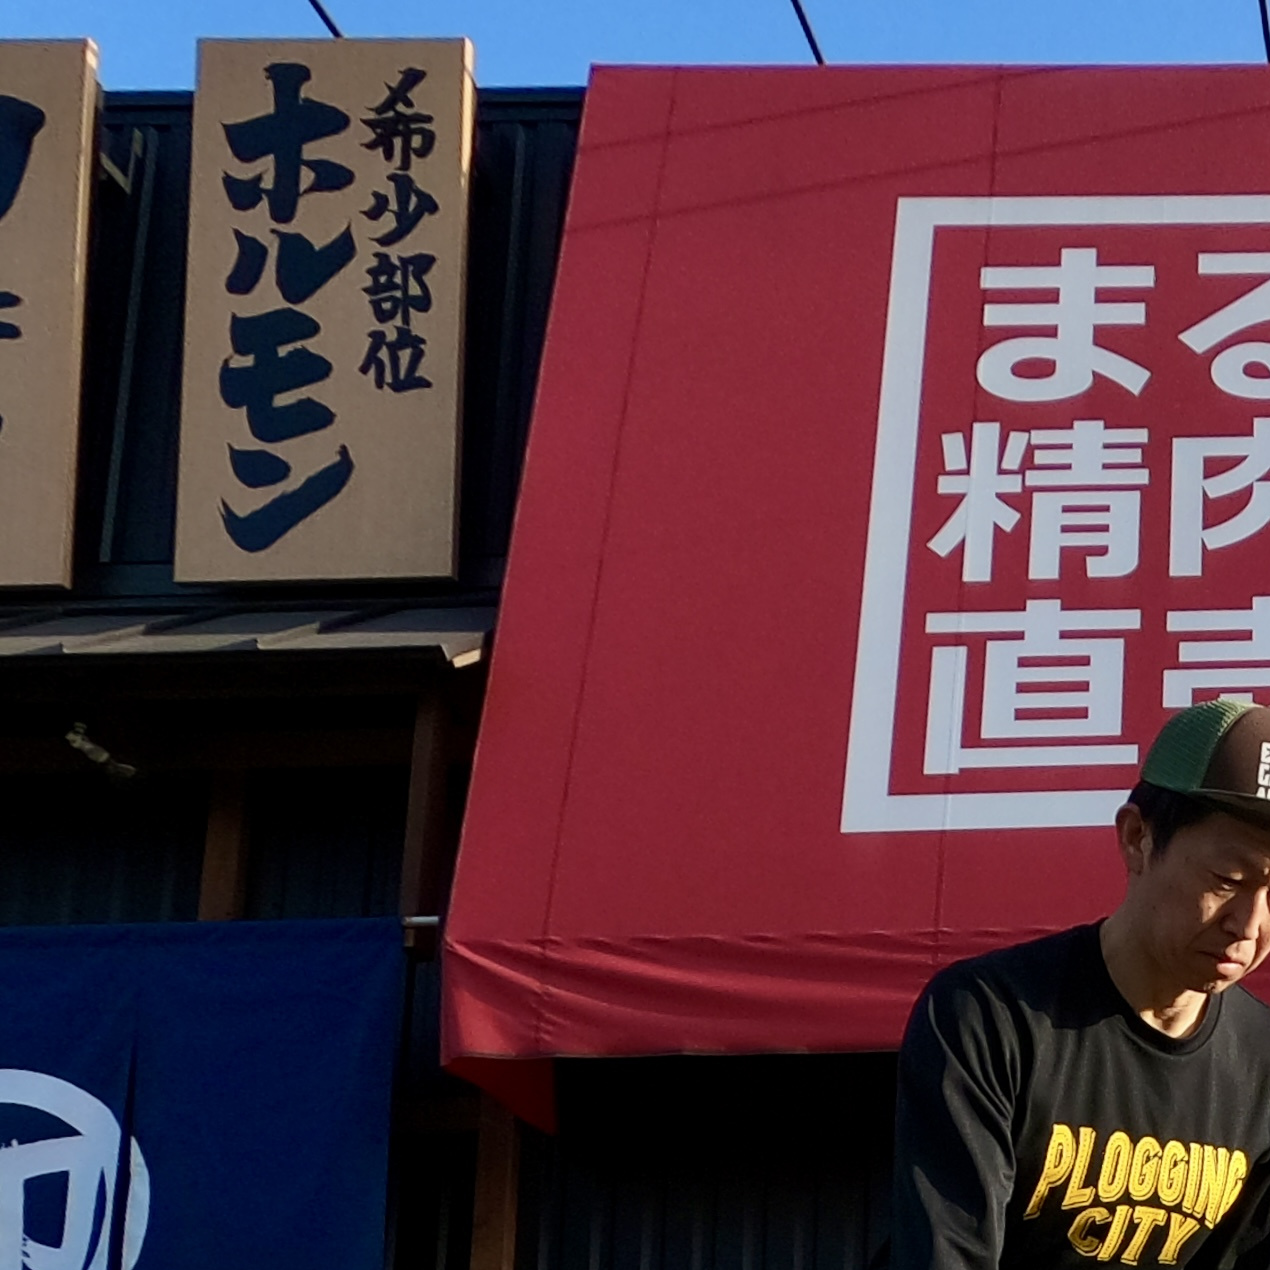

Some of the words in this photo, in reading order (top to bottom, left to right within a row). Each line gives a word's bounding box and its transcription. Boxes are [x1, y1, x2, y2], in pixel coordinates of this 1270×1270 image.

[219, 62, 357, 553] ホルモン
[360, 67, 439, 393] 希少部位
[1023, 1123, 1247, 1229] PLOGGING
[1067, 1205, 1200, 1266] CITY
